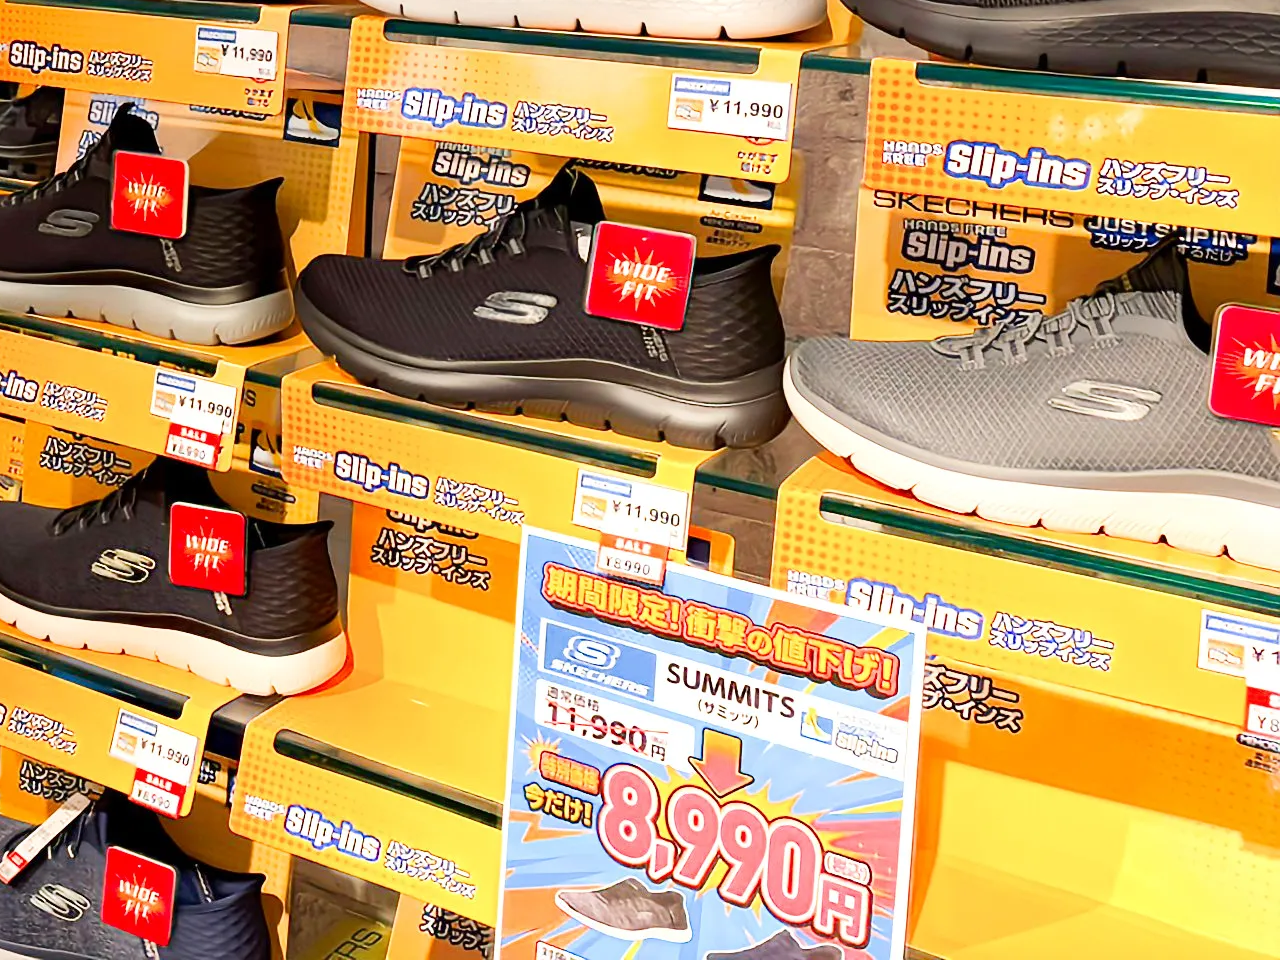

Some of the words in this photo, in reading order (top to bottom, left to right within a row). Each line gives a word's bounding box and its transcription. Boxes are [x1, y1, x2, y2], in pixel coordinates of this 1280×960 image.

[10, 40, 85, 74] Slip-ins
[88, 50, 153, 67] ハンズフリー
[221, 43, 273, 64] ¥11,990
[401, 87, 508, 128] Slip-ins
[514, 100, 608, 124] ハンズフリー
[710, 99, 784, 120] ¥11,990
[882, 140, 943, 156] HANDS
[882, 153, 927, 168] FREE
[944, 140, 1092, 188] Slip-ins
[432, 149, 530, 189] Slip-ins
[1099, 158, 1231, 185] ハンズフリー
[127, 182, 167, 200] WIDE
[1096, 177, 1239, 210] スリップ・インズ
[873, 191, 1075, 229] SKECHERS
[964, 223, 1007, 238] FREE
[902, 232, 1035, 274] Slip-ins
[612, 260, 671, 284] WIDE
[889, 270, 1047, 306] ハンズフリー
[622, 281, 658, 302] FIT
[179, 395, 232, 418] ¥11,990
[44, 436, 132, 469] ハンズフリー
[334, 452, 429, 500] Slip-ins
[435, 475, 520, 506] ハンズフリー
[611, 499, 681, 528] ¥11,990
[185, 535, 229, 555] WIDE
[377, 527, 488, 567] ハンズフリー
[370, 549, 491, 591] スリップ・インズ
[992, 611, 1114, 651] ハンズフリー
[989, 629, 1112, 672] スリップインズ
[550, 658, 650, 696] SKECHERS
[666, 662, 796, 719] SUMMITS
[698, 700, 759, 729] (サミッツ)
[141, 737, 190, 767] ¥11,990
[523, 783, 593, 828] 今だけ!
[285, 804, 381, 862] Slip-ins
[387, 839, 470, 879] ハンズフリー
[118, 879, 160, 904] WIDE
